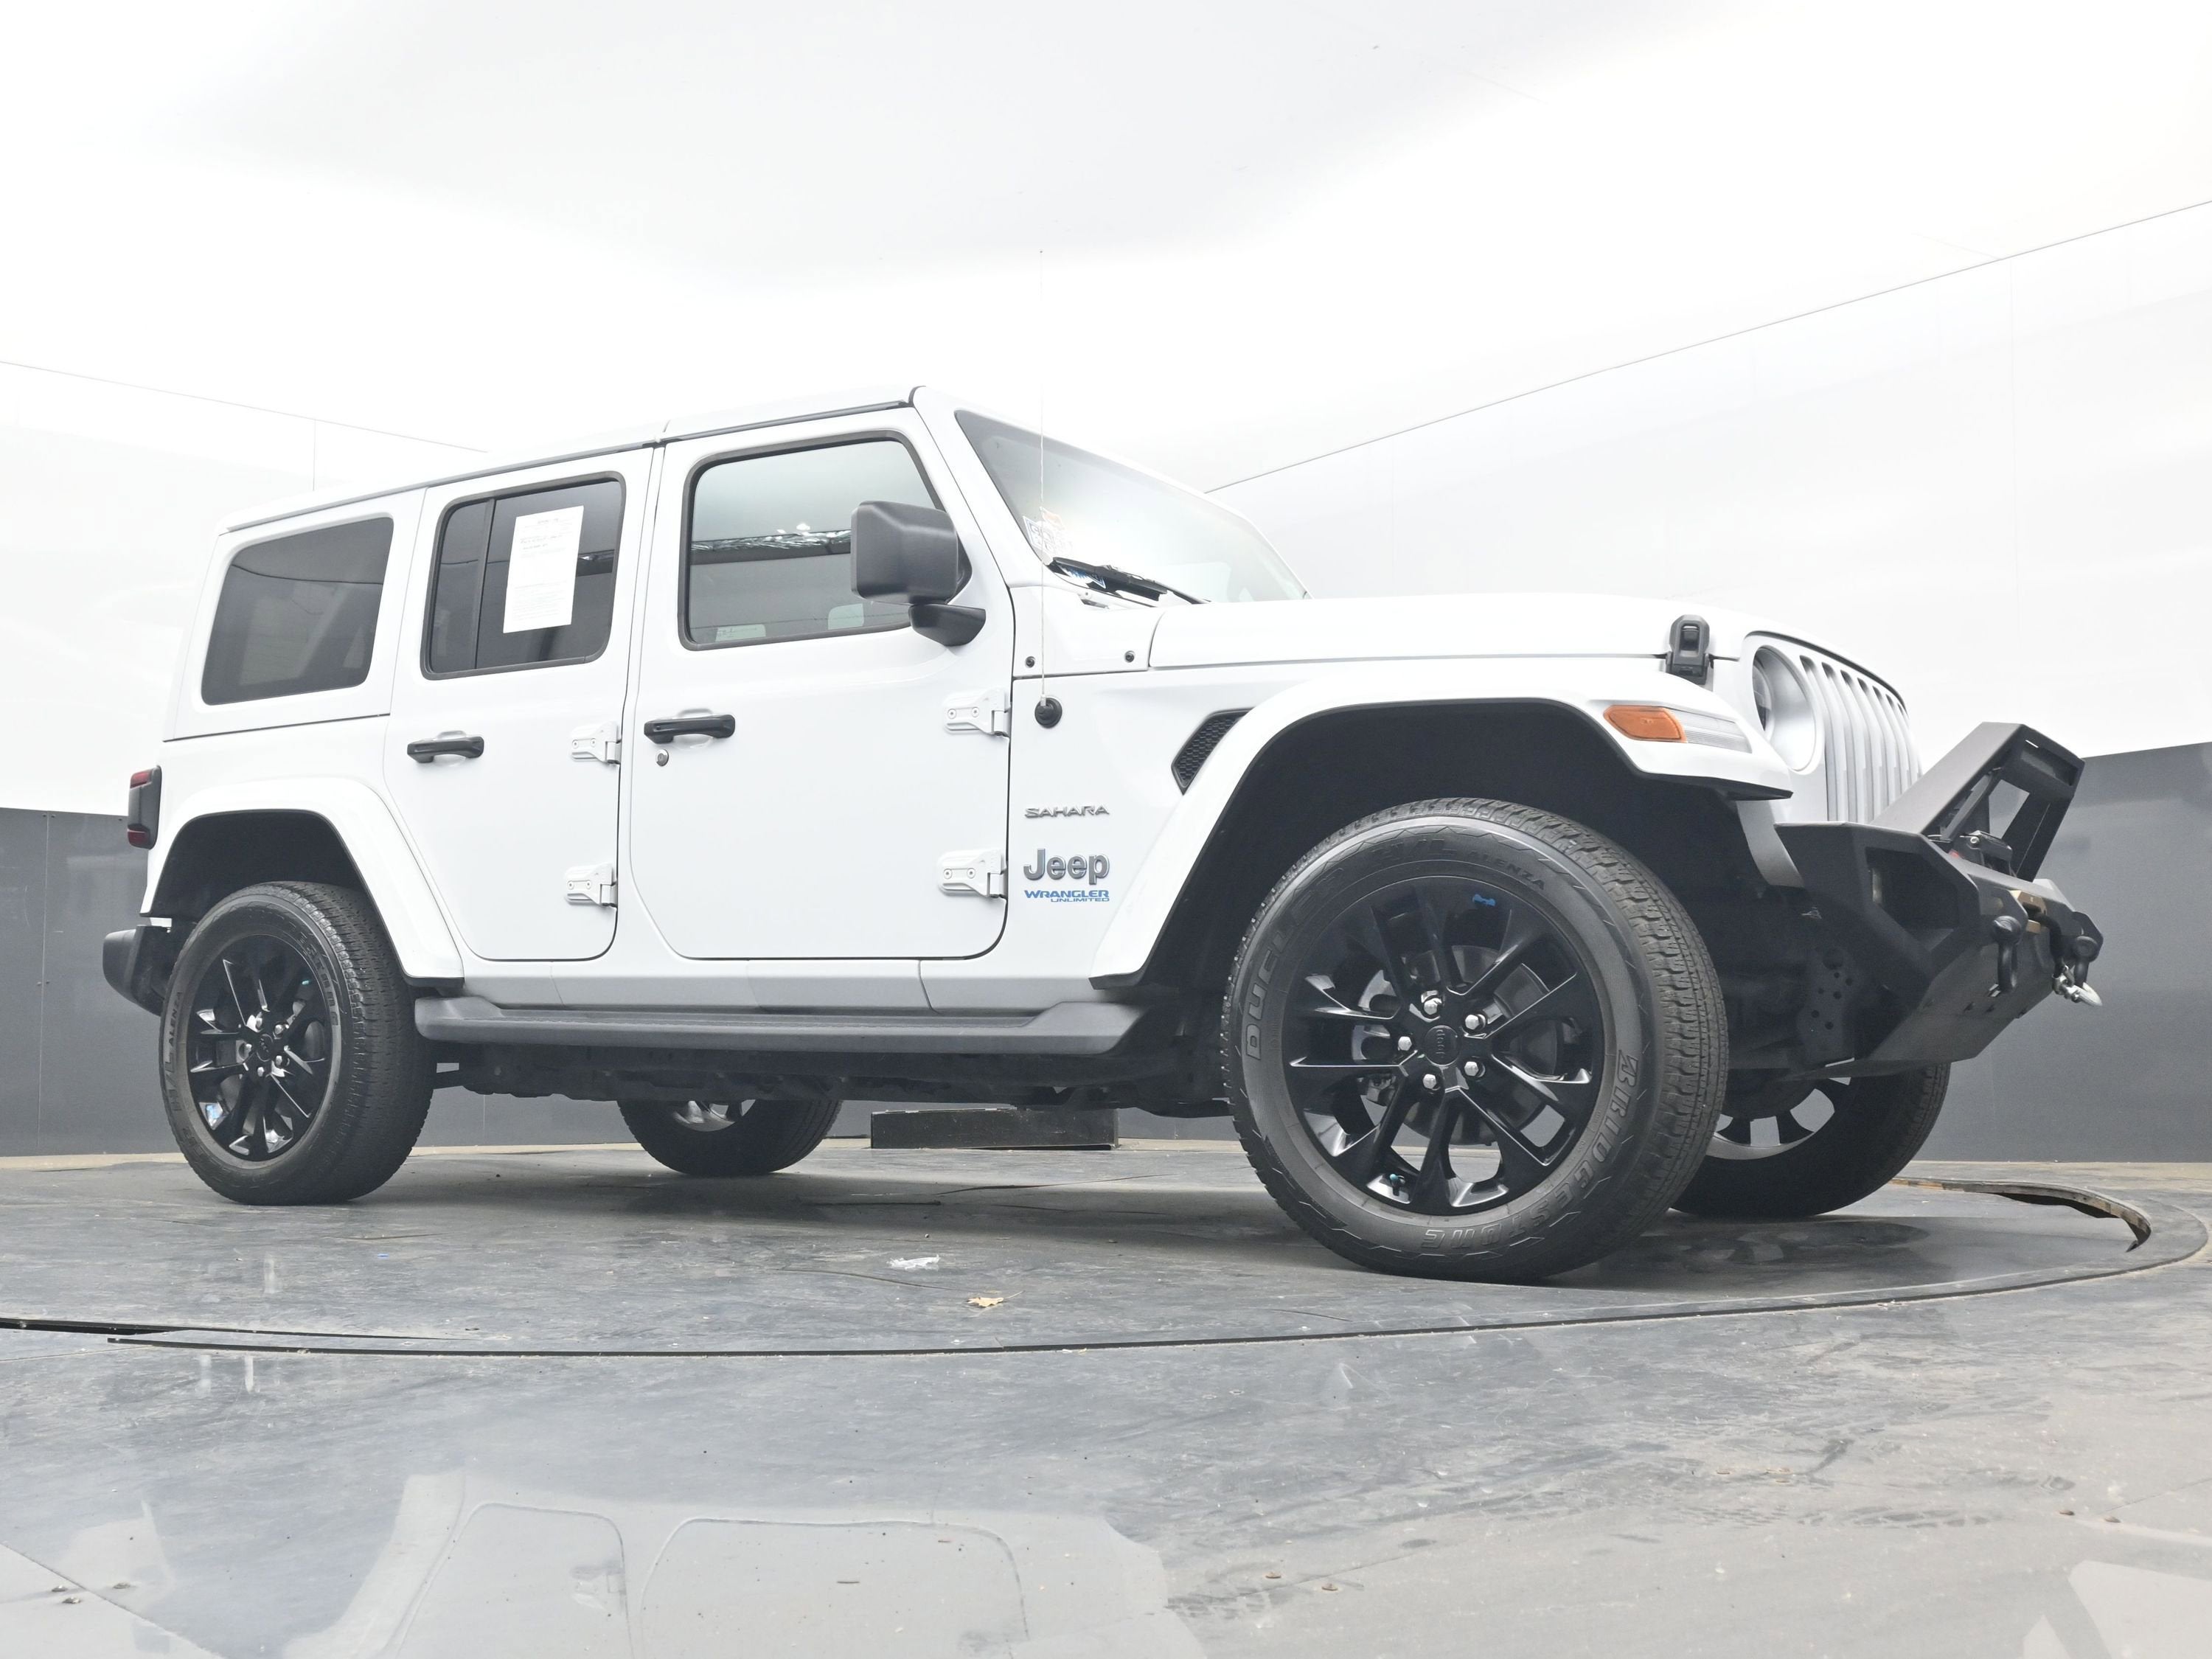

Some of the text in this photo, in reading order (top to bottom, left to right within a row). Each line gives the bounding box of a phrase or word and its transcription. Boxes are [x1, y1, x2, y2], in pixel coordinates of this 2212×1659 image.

[1024, 805, 1110, 818] SAHARA
[1023, 848, 1110, 886] Jeep
[1468, 849, 1546, 891] ALENZA
[1024, 889, 1110, 898] WRANGLER
[1420, 1049, 1638, 1249] BRIDGESTONE
